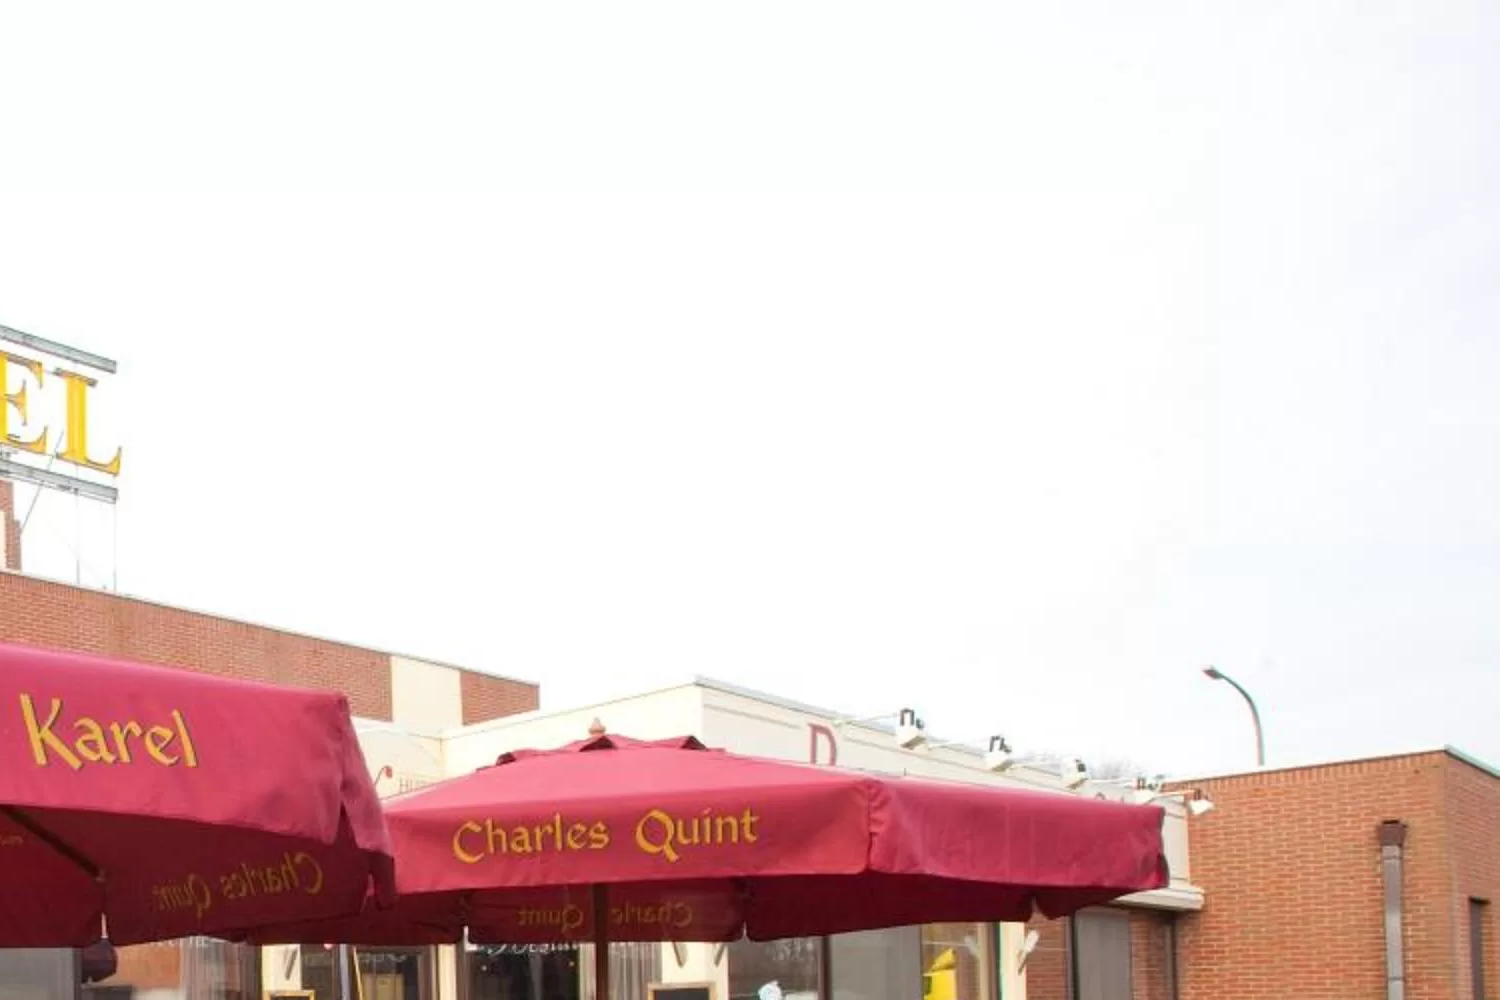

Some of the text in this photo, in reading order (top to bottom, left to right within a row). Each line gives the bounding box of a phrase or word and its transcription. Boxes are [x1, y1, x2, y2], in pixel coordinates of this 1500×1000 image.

[19, 693, 198, 769] Karel
[452, 807, 759, 863] Charles Quint
